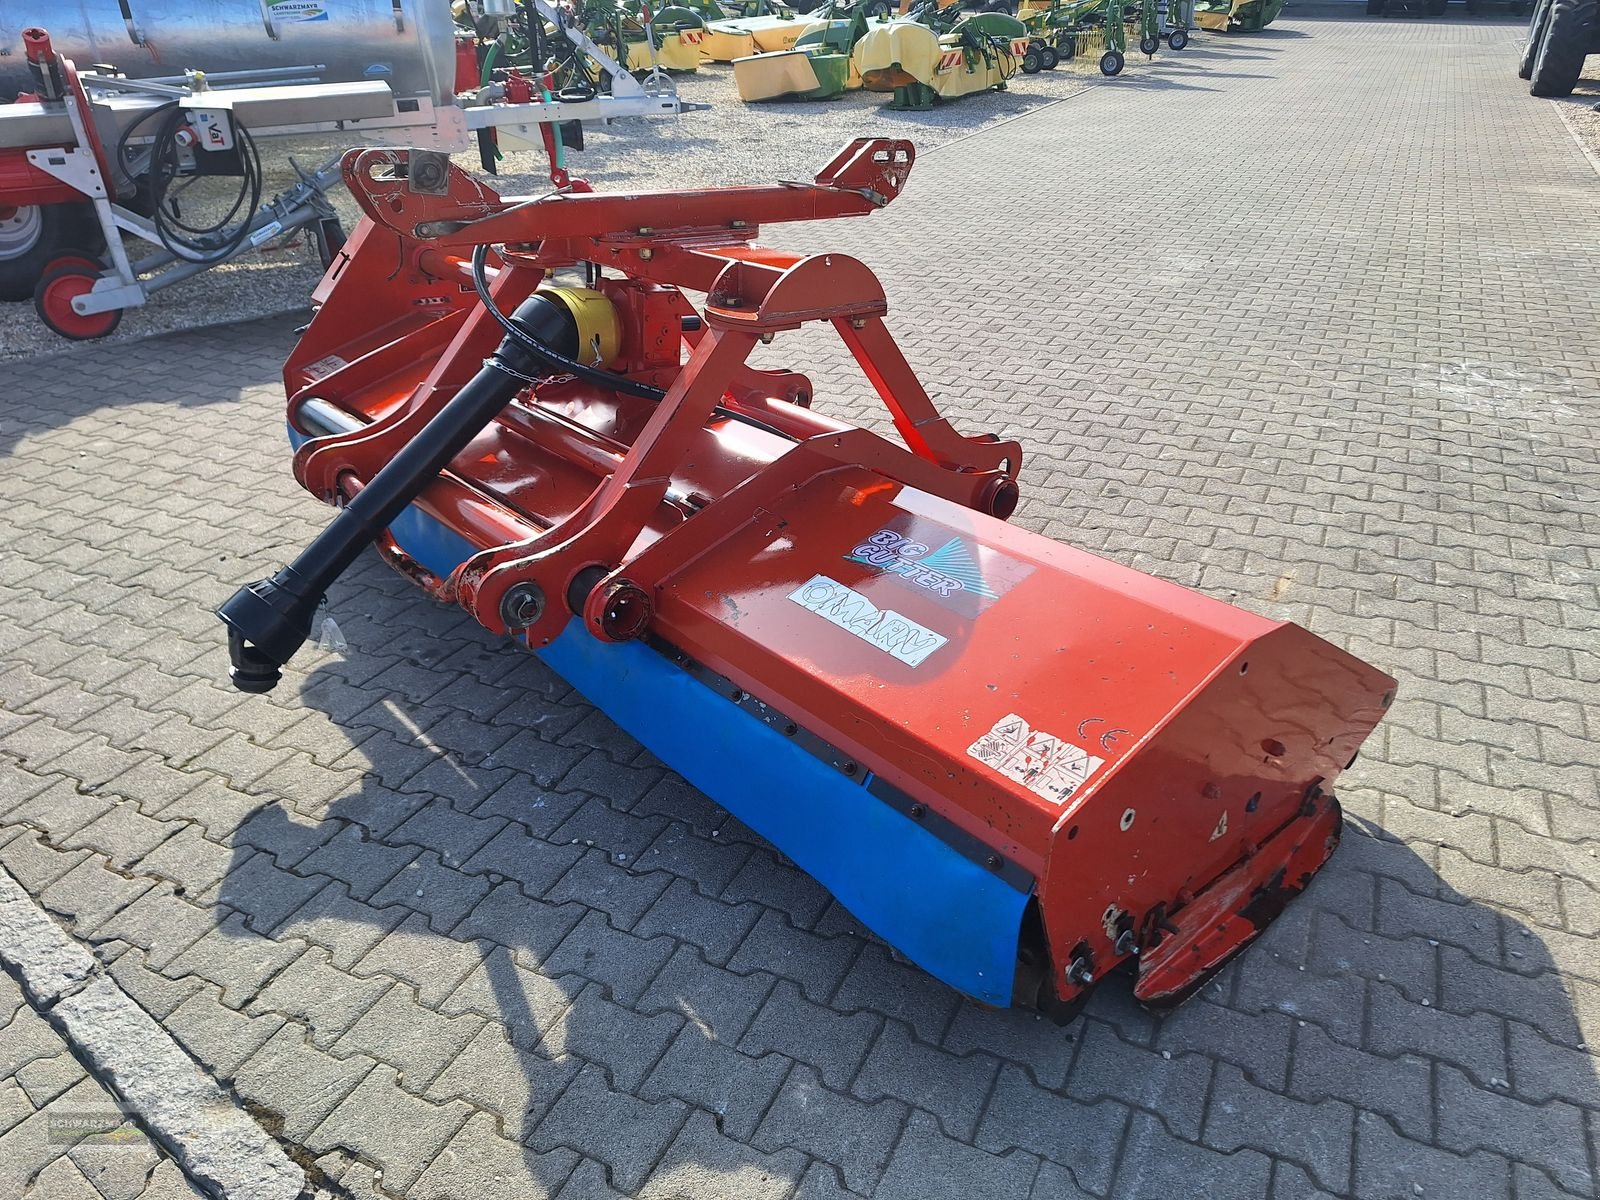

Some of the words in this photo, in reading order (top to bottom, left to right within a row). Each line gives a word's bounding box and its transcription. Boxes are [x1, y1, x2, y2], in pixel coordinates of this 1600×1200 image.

[271, 3, 318, 11] SCHWARZMAYR
[868, 529, 928, 557] BIG
[851, 544, 965, 597] CUTTER
